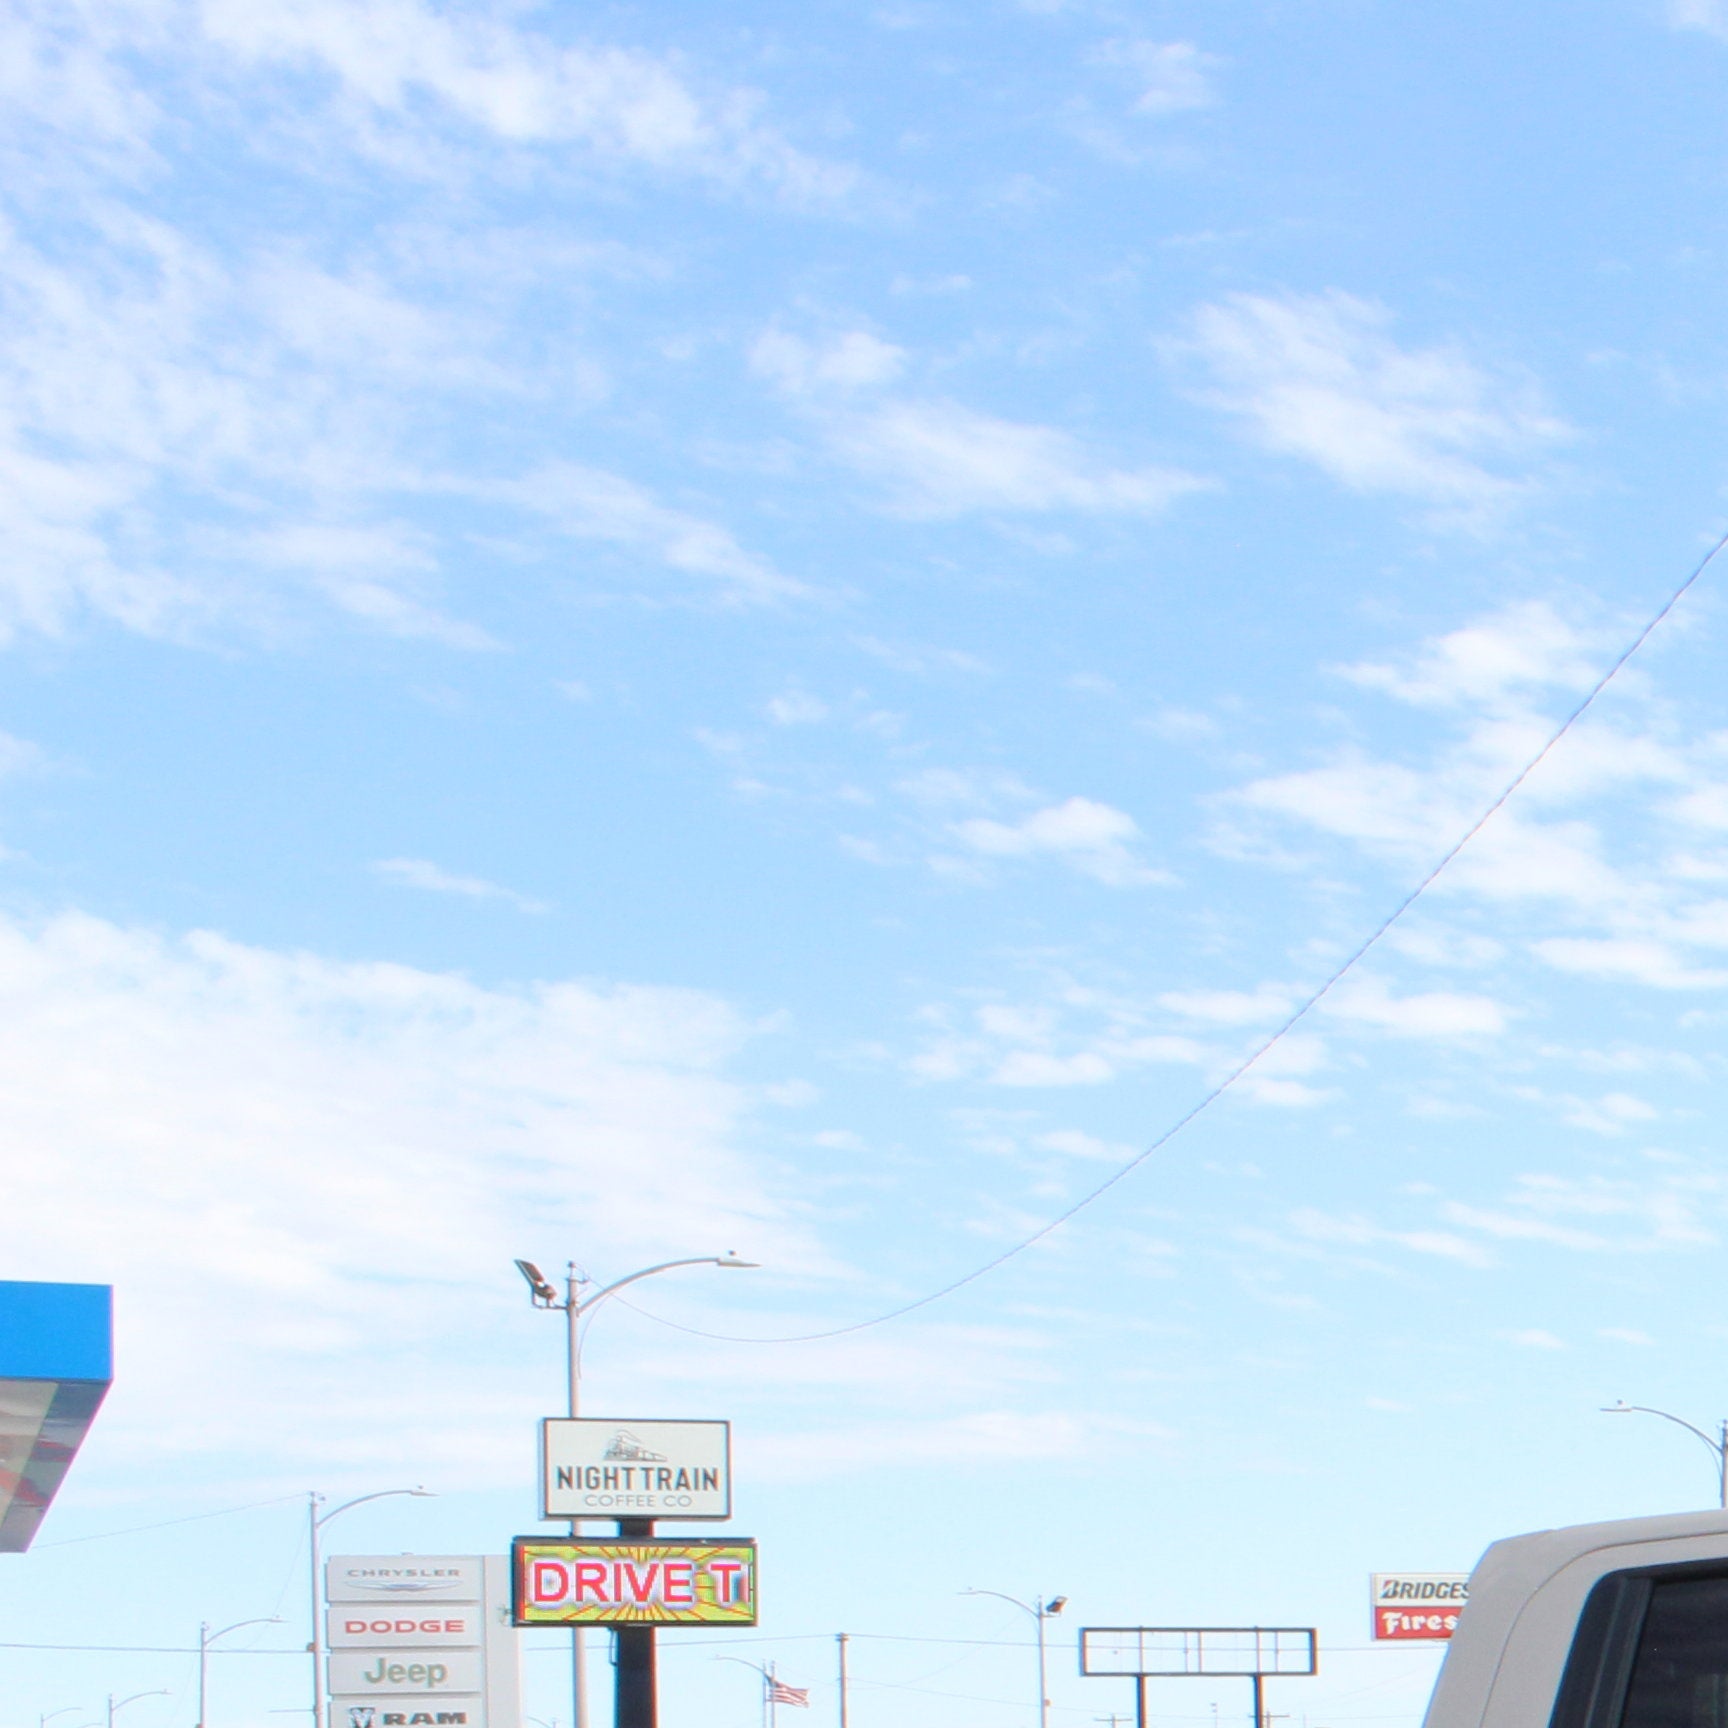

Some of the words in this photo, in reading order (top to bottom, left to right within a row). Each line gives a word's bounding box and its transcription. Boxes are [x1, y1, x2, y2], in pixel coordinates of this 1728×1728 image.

[584, 1494, 655, 1508] COFFEE
[663, 1494, 693, 1508] CO
[347, 1569, 461, 1578] CHRYSLER
[533, 1562, 694, 1602] DRIVE
[710, 1563, 751, 1602] T
[1381, 1579, 1471, 1599] BRIDGES
[345, 1620, 465, 1634] DODGE
[364, 1658, 449, 1688] Jeep
[383, 1711, 468, 1726] RAM
